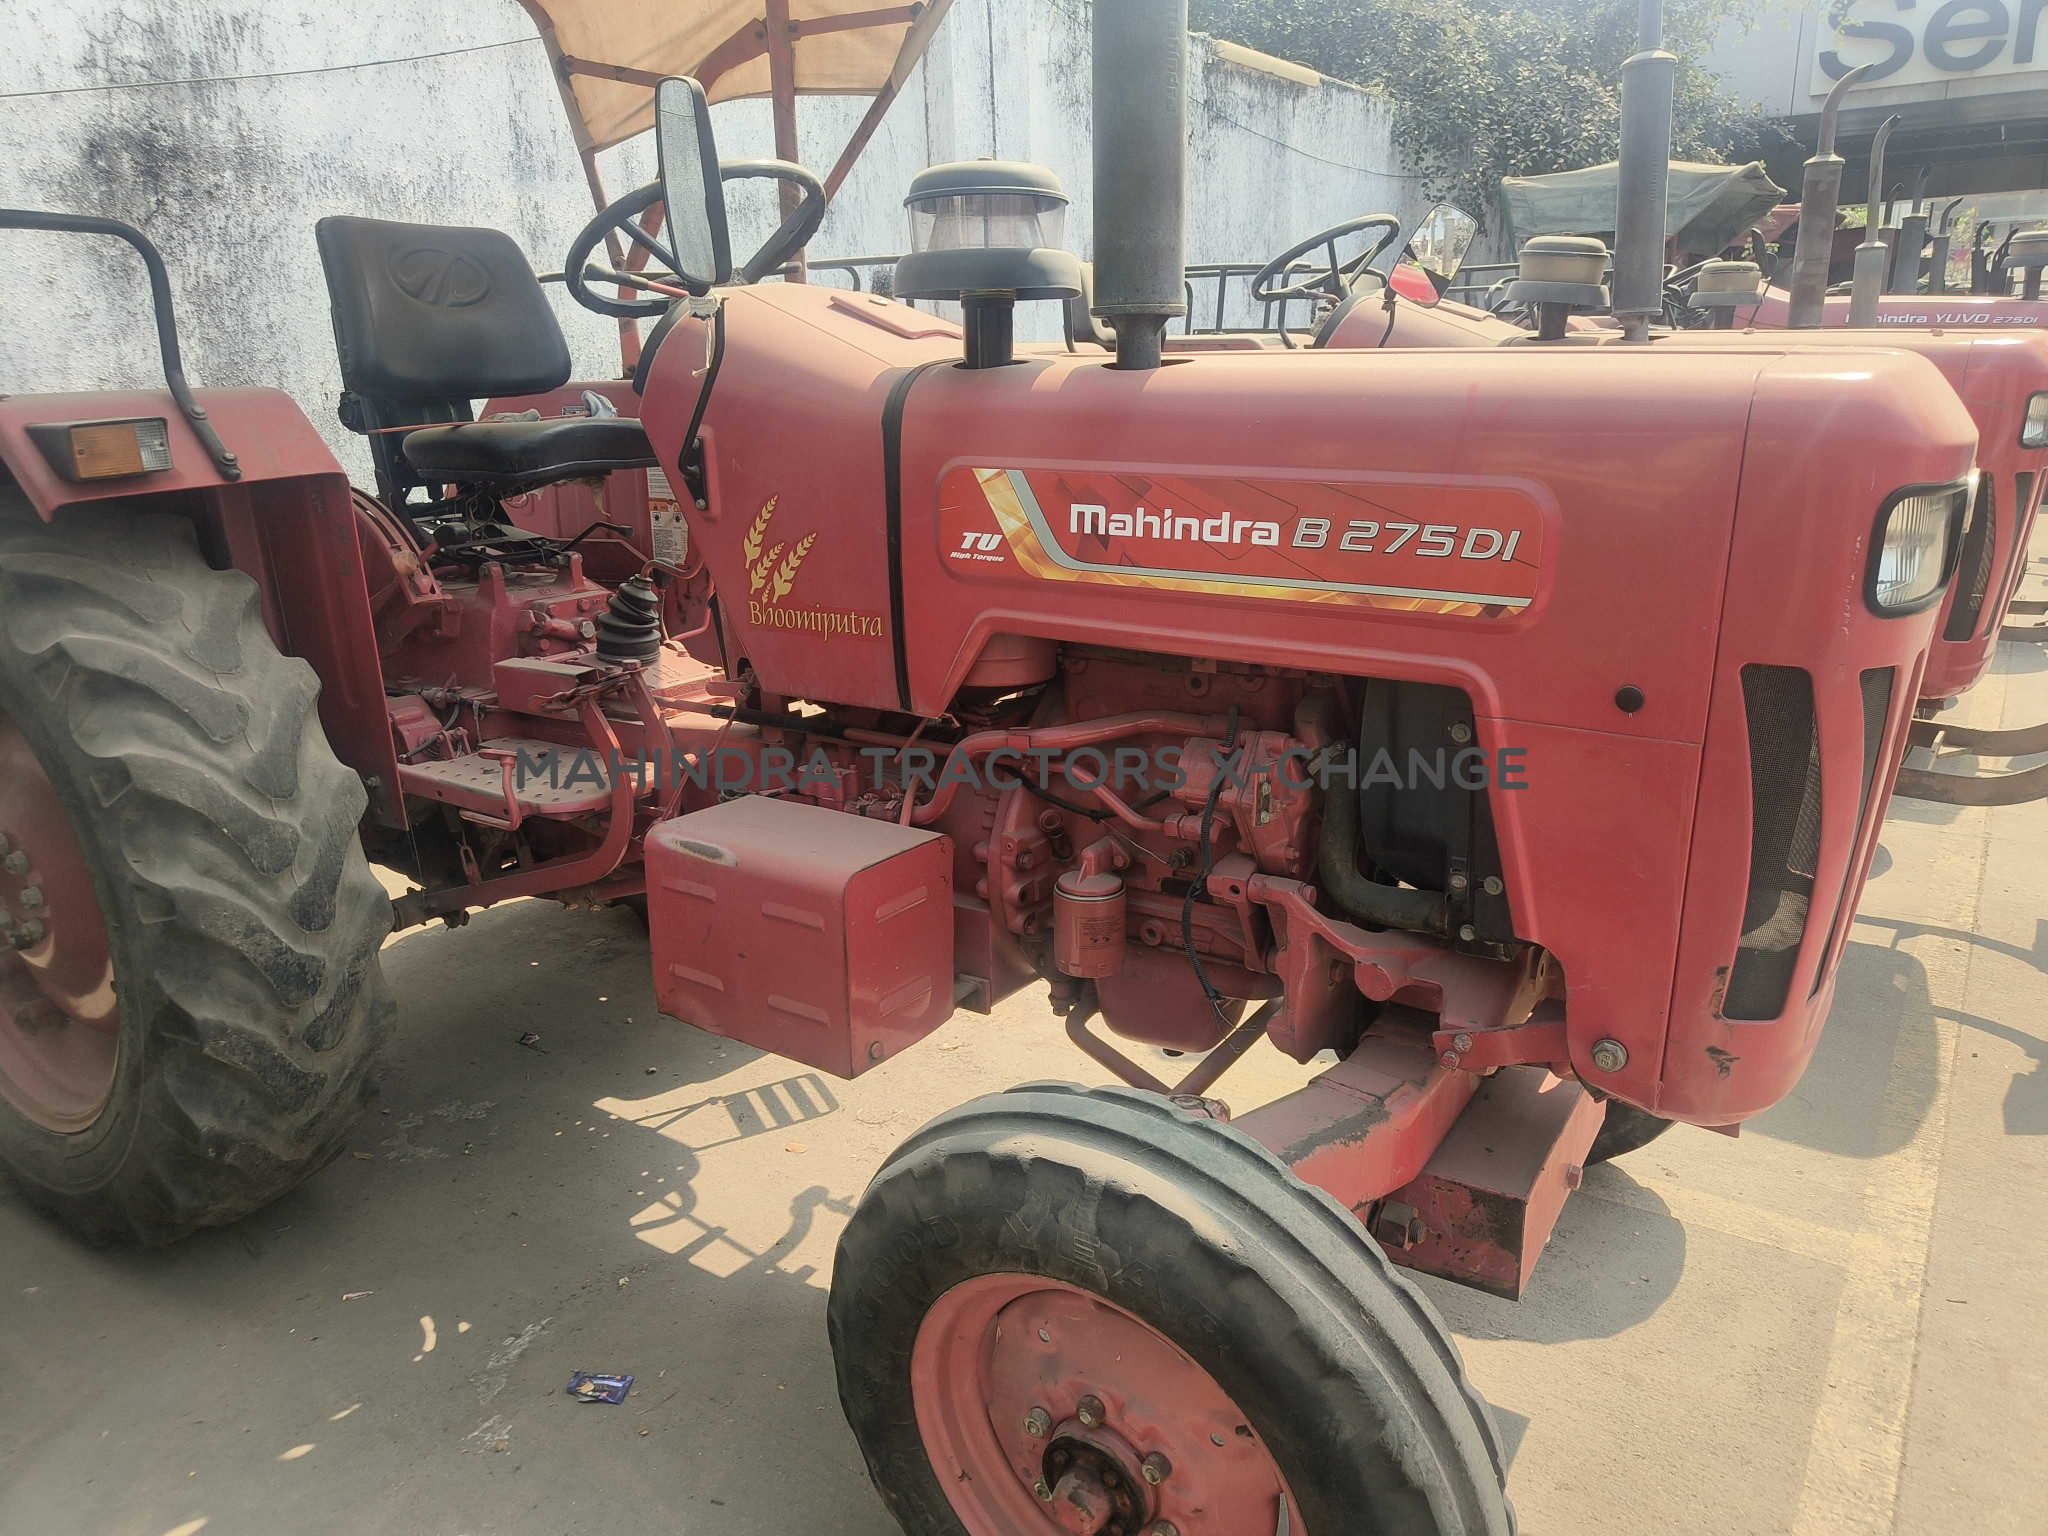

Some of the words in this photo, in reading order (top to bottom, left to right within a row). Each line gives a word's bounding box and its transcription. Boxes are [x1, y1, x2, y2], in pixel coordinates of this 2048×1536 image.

[1845, 313, 1928, 325] indra
[1935, 313, 1990, 325] YUVO
[1992, 316, 2038, 325] 275DI
[1069, 503, 1280, 547] Mahindra
[1291, 517, 1332, 549] B
[960, 531, 1004, 551] TU
[949, 551, 972, 560] High
[972, 553, 1005, 562] Torque
[748, 600, 884, 642] Bhoomiputra
